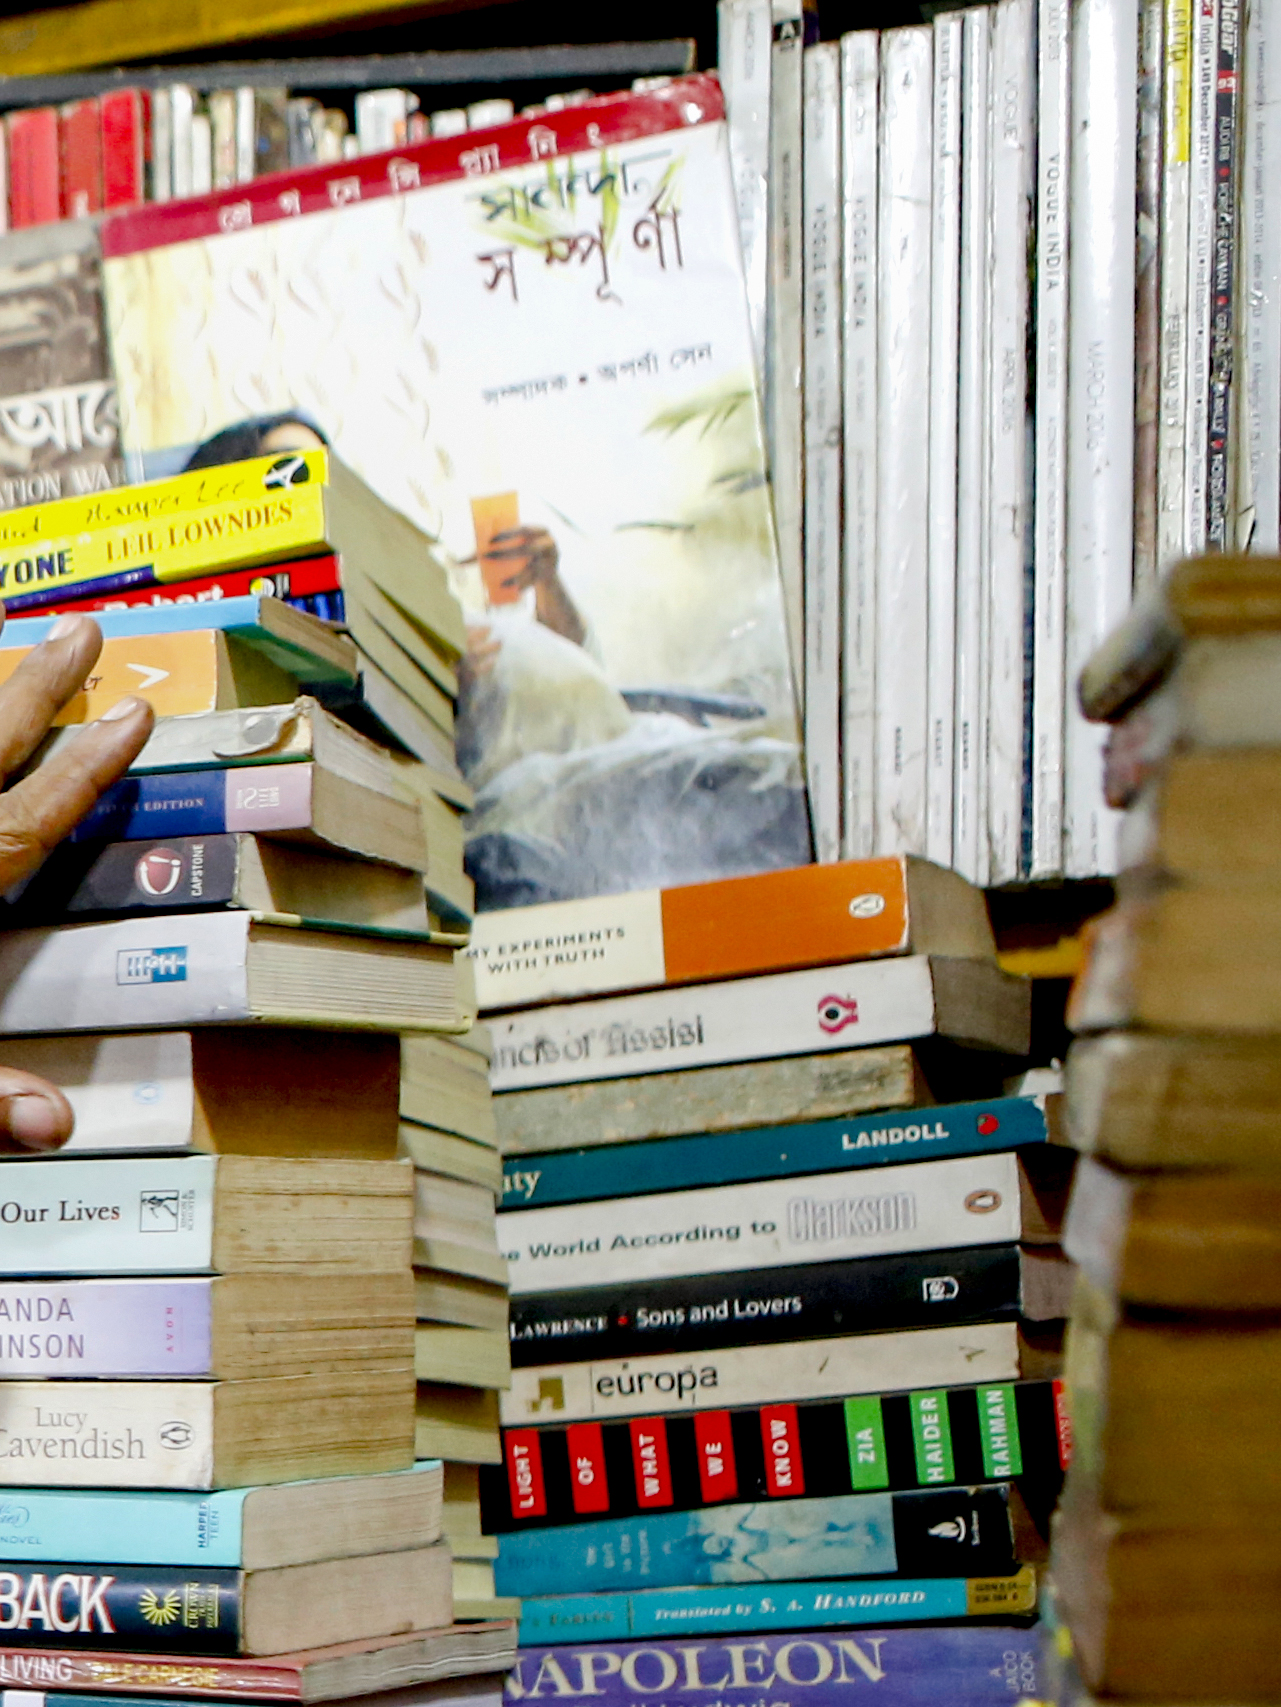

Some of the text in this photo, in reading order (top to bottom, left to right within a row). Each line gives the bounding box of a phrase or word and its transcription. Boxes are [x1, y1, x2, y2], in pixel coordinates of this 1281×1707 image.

[1003, 72, 1019, 142] VOGUE
[1045, 152, 1061, 292] VOGUE INDIA
[105, 499, 295, 563] LEIL LOWNDES
[143, 797, 205, 813] EDITION
[191, 842, 205, 898] CAPSTONE
[487, 946, 606, 975] WITH TRUTH
[497, 926, 627, 958] EXPERIMENTS
[841, 1121, 950, 1151] LANDOLL
[0, 1201, 50, 1224] Our
[58, 1199, 122, 1223] Lives
[529, 1191, 917, 1261] World According to Clarkson
[509, 1294, 803, 1341] LAWRENCE Sons and Lovers
[595, 1362, 720, 1403] europa
[34, 1406, 88, 1435] Lucy
[921, 1395, 946, 1483] HAIDER
[983, 1388, 1012, 1477] RAHMAN
[639, 1432, 662, 1499] WHAT
[705, 1440, 725, 1477] WE
[770, 1418, 794, 1489] KNOW
[857, 1426, 879, 1464] ZIA
[513, 1442, 537, 1510] LIGHT
[577, 1455, 596, 1486] OF
[0, 1536, 42, 1546] NOVEL
[197, 1502, 208, 1549] HARPER
[210, 1509, 219, 1541] TEEN
[653, 1588, 927, 1624] Translated by S. A. HANDFORD
[0, 1655, 74, 1682] LIVING
[1002, 1650, 1019, 1693] JAICO
[1019, 1651, 1036, 1693] BOOK
